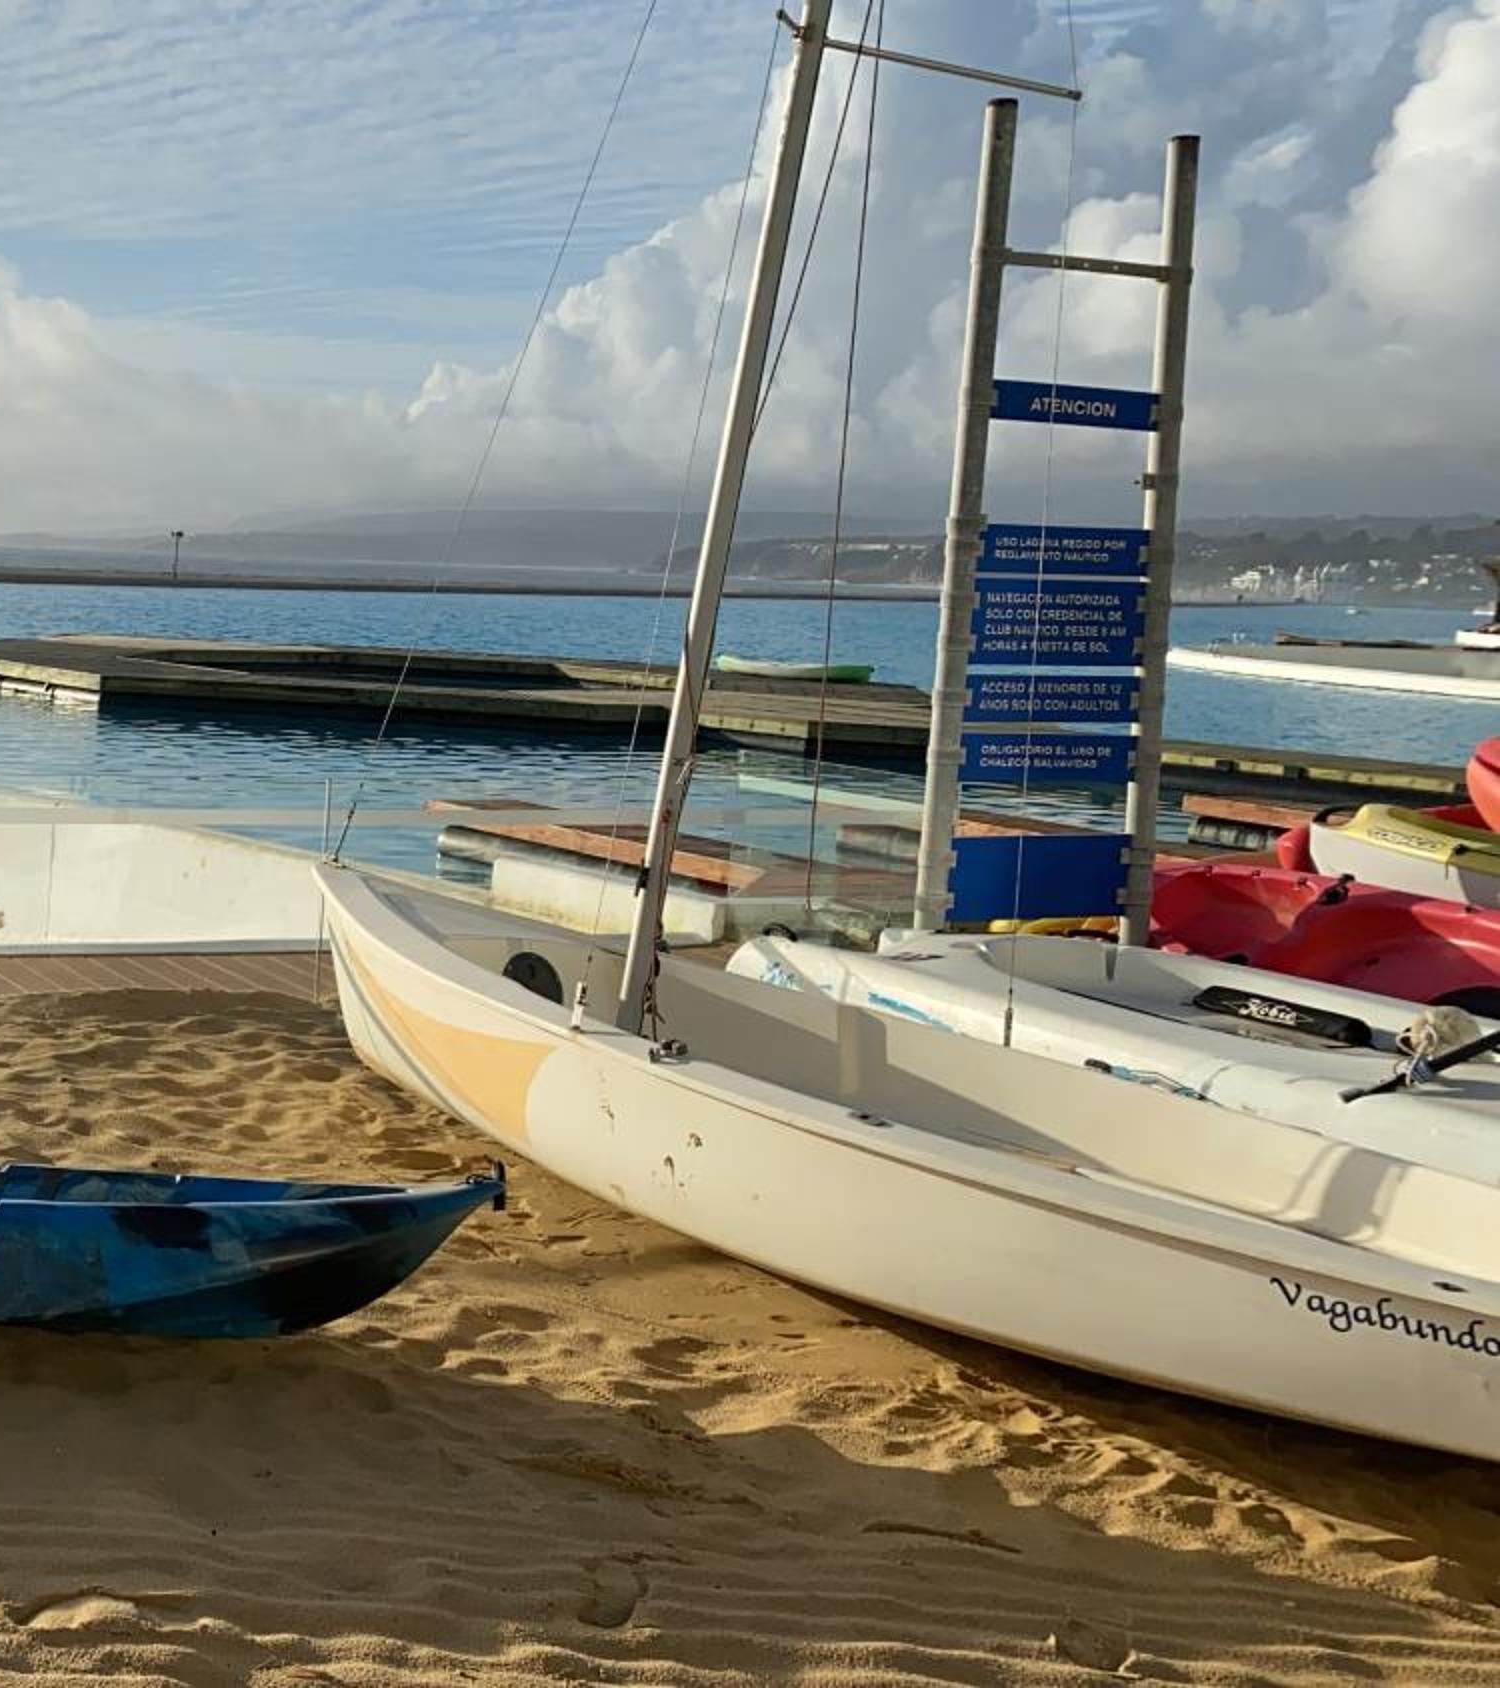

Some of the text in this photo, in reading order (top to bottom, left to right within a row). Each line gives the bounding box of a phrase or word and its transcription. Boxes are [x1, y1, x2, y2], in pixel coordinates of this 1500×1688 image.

[1030, 396, 1117, 418] ATENCION
[995, 538, 1018, 546] USO
[1103, 540, 1126, 549] POR
[1056, 594, 1120, 605] AUTORIZADA
[985, 609, 1014, 619] SOLO
[1041, 610, 1104, 621] CREDENCIAL
[1108, 612, 1122, 621] DE
[985, 625, 1011, 635] CLUB
[1065, 627, 1099, 637] DESDE
[983, 640, 1018, 651] HORAS
[1073, 642, 1086, 652] DE
[1090, 642, 1109, 652] SOL
[982, 682, 1024, 693] ACCESO
[1038, 684, 1089, 694] MENORES
[1093, 684, 1106, 694] DE
[1044, 700, 1067, 710] CON
[1070, 700, 1119, 711] ADULTOS
[981, 745, 1111, 757] OBLIGATORIO EL USO DE
[980, 757, 1029, 767] CHALECO
[1269, 1277, 1500, 1356] Vagabundo
